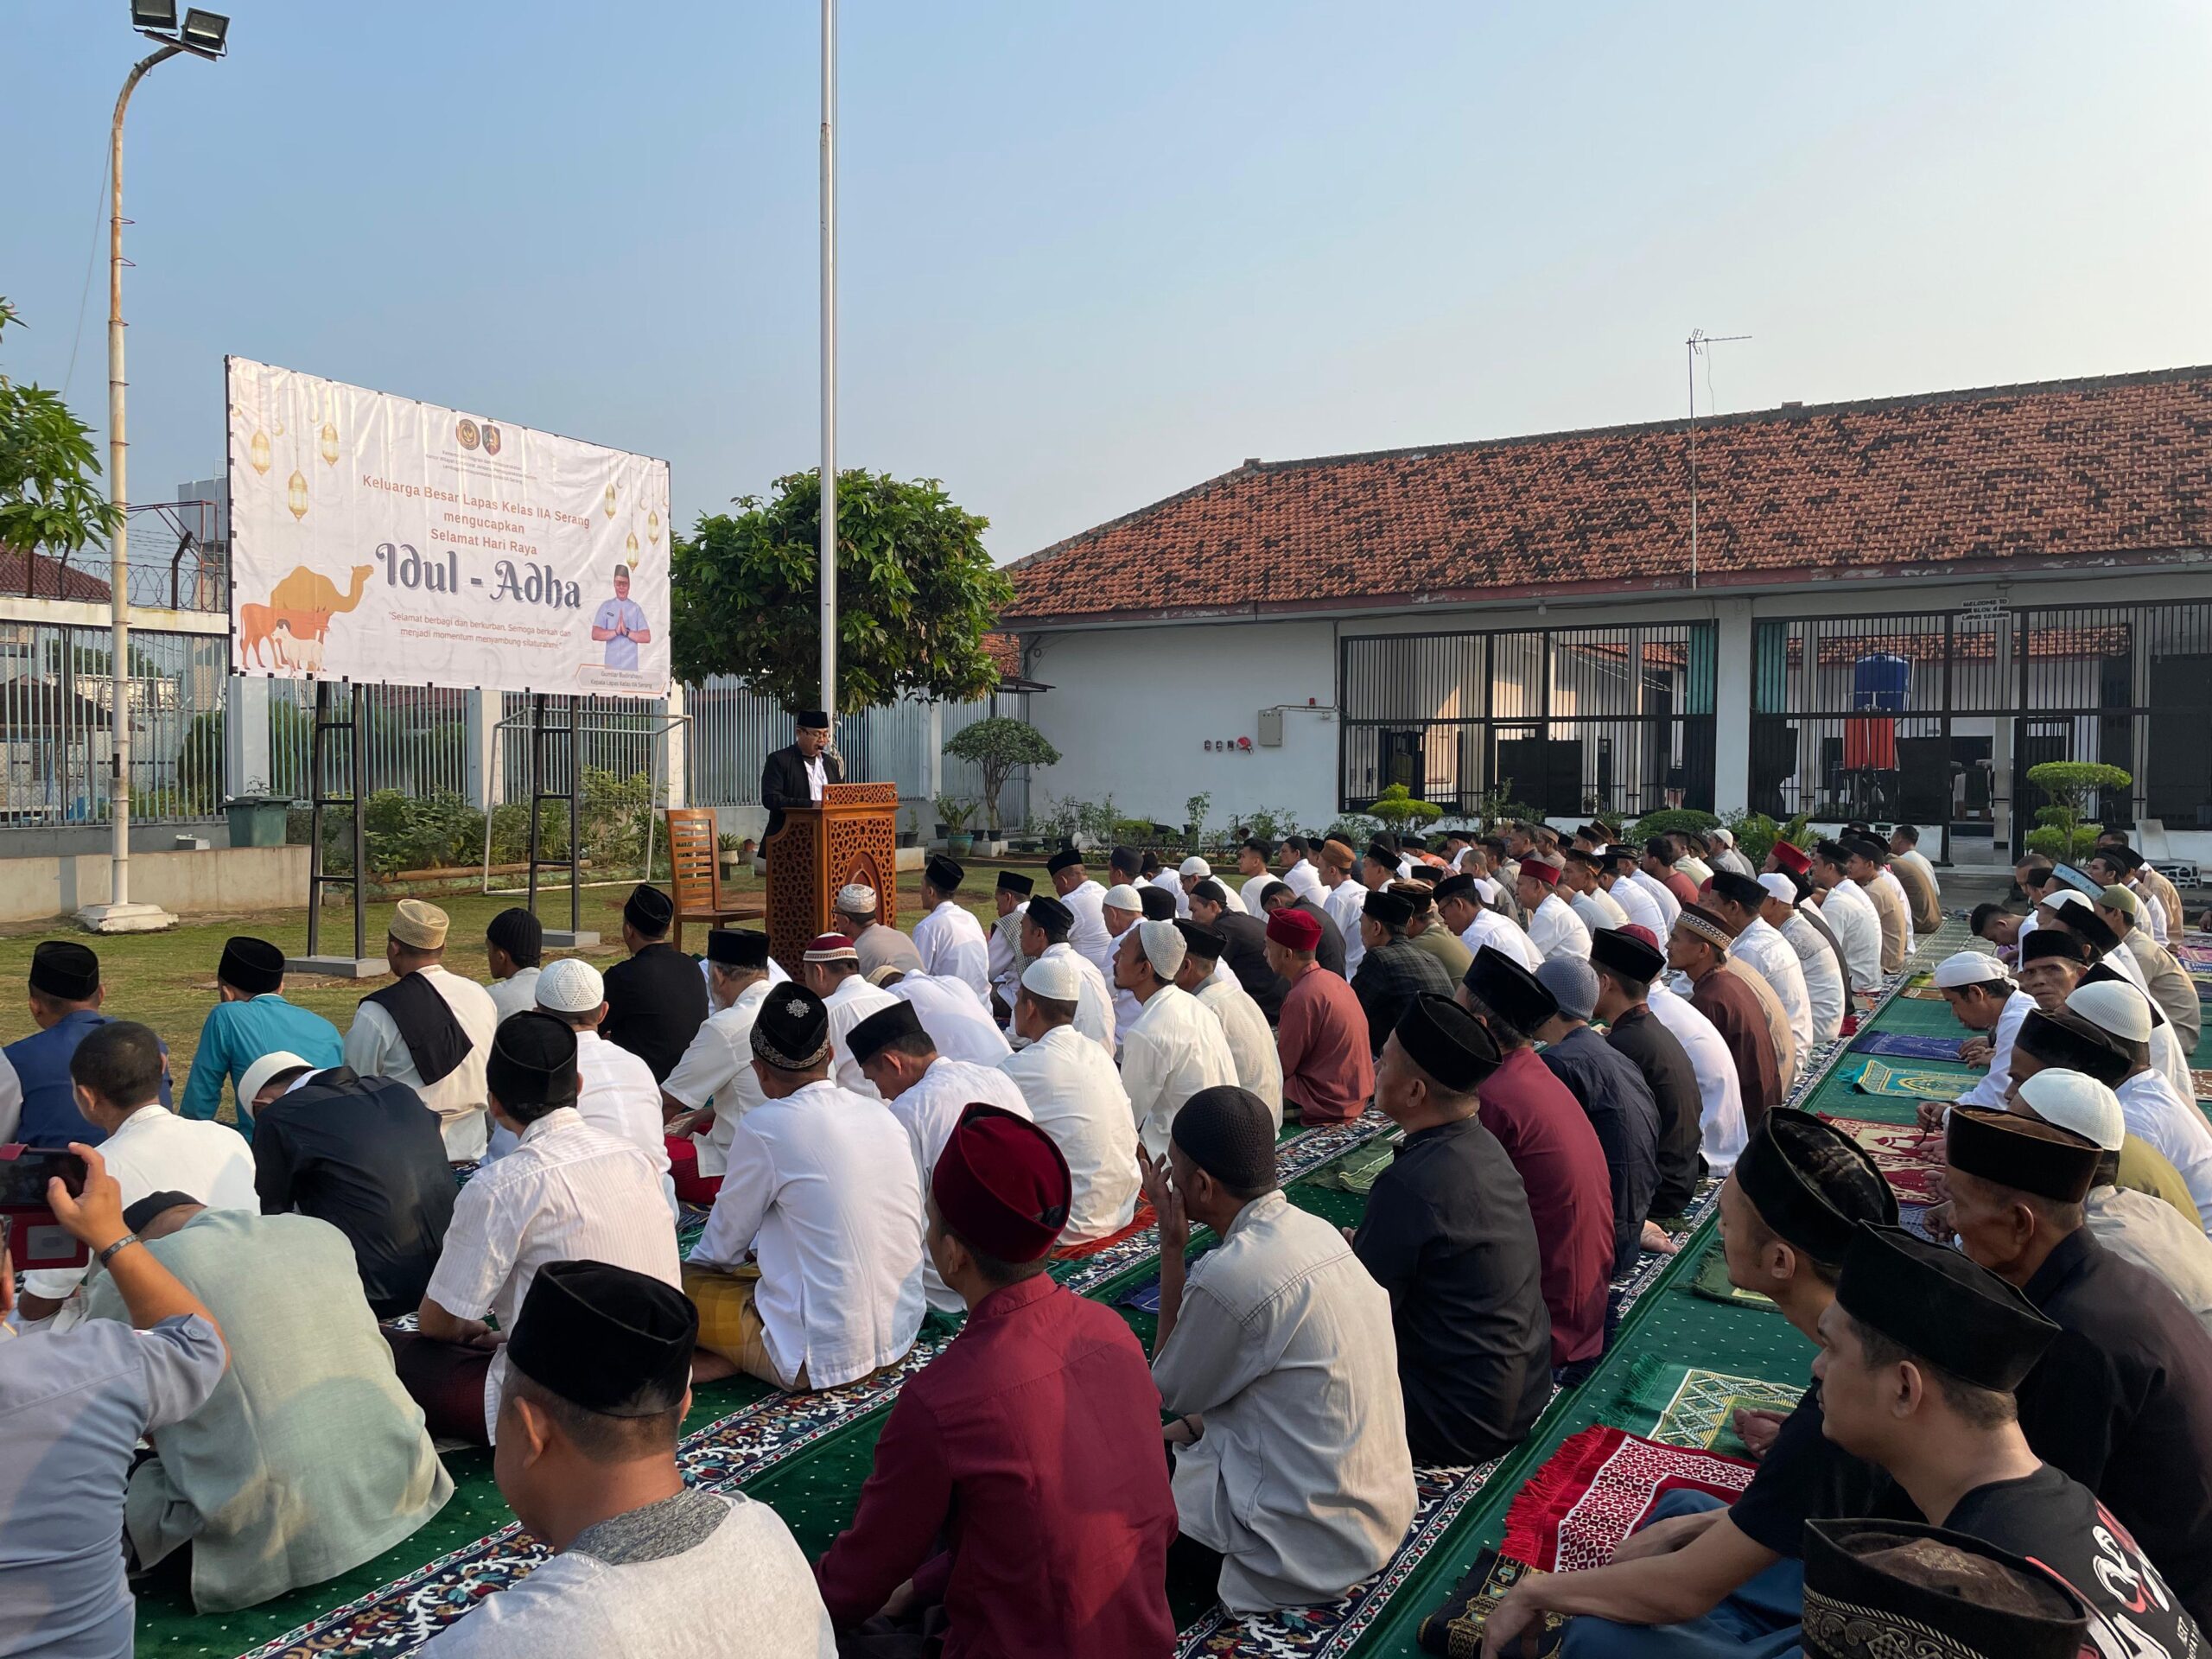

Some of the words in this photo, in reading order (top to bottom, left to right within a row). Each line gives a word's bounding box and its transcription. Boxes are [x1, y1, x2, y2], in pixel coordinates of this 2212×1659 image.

[363, 474, 421, 498] Keluarga
[424, 486, 459, 504] Besar
[463, 493, 499, 511] Lapas
[502, 501, 533, 517] Kelas
[537, 507, 551, 519] IIA
[555, 511, 590, 530] Serang
[443, 512, 525, 534] mengucapkan
[430, 528, 479, 546] Selamat
[483, 536, 506, 550] Hari
[510, 541, 537, 556] Raya
[375, 543, 458, 595] Idul
[489, 560, 582, 610] Adha
[388, 611, 423, 623] "Selamat
[424, 614, 453, 627] berbagi
[454, 619, 468, 627] dan
[508, 623, 535, 635] Semoga
[537, 627, 558, 636] berkah
[400, 628, 431, 639] menjadi
[433, 631, 474, 642] momentum
[475, 635, 521, 647] menyambung
